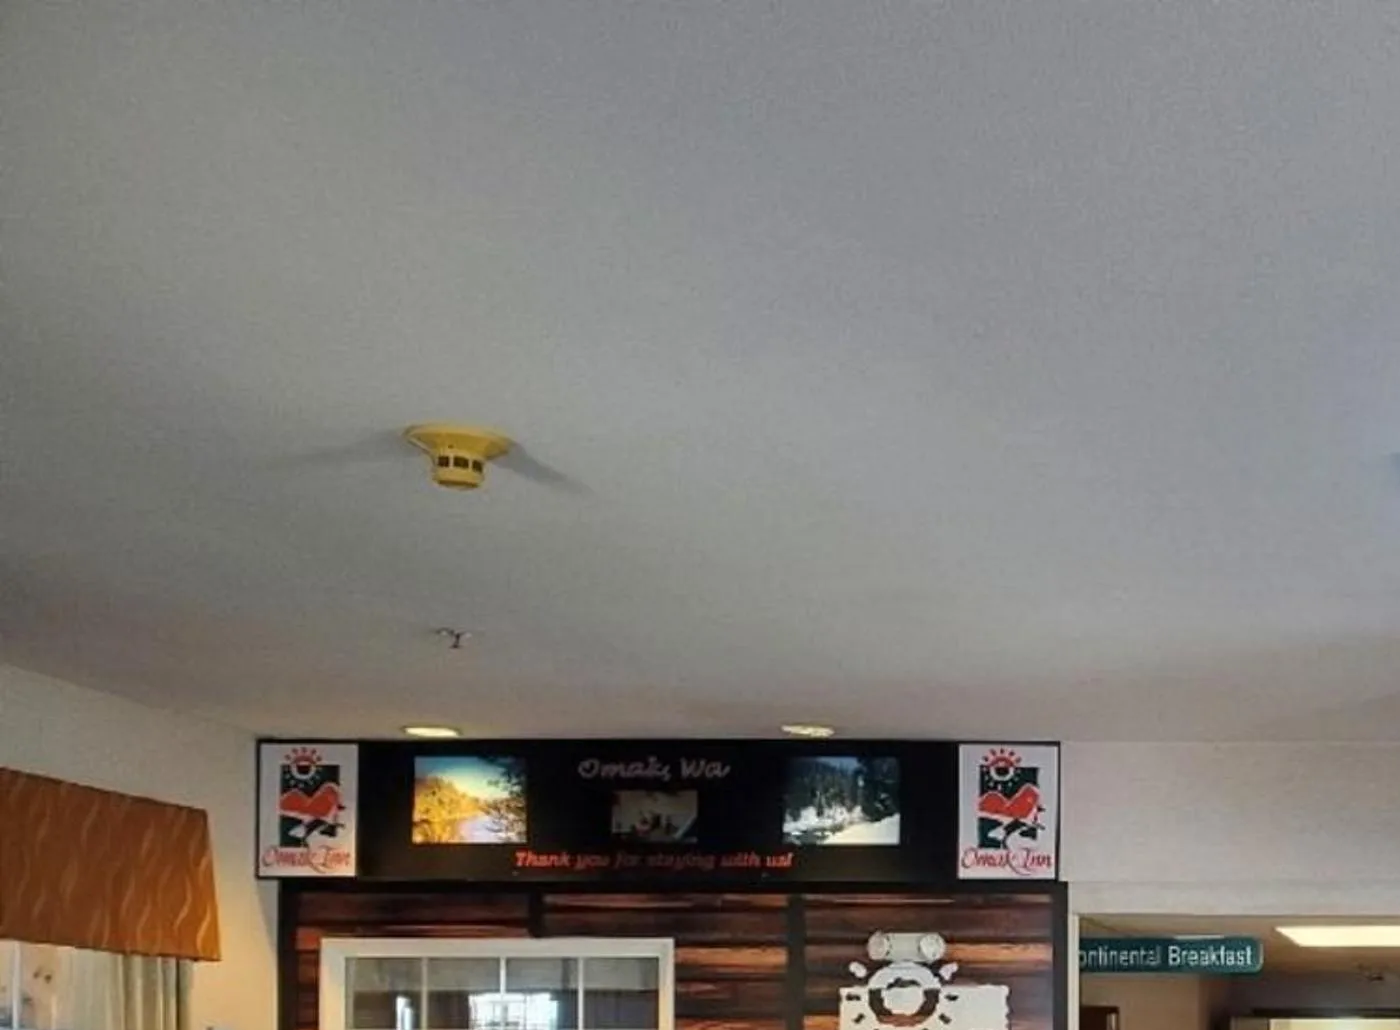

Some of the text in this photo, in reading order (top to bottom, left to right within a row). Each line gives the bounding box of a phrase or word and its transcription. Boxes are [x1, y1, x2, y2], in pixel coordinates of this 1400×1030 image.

[515, 851, 570, 867] Thank
[574, 853, 610, 870] you
[614, 851, 642, 869] for
[647, 851, 717, 869] staying
[720, 851, 761, 868] with
[961, 847, 1052, 876] Omak Inn
[1079, 945, 1253, 967] ontinental Breakfast
